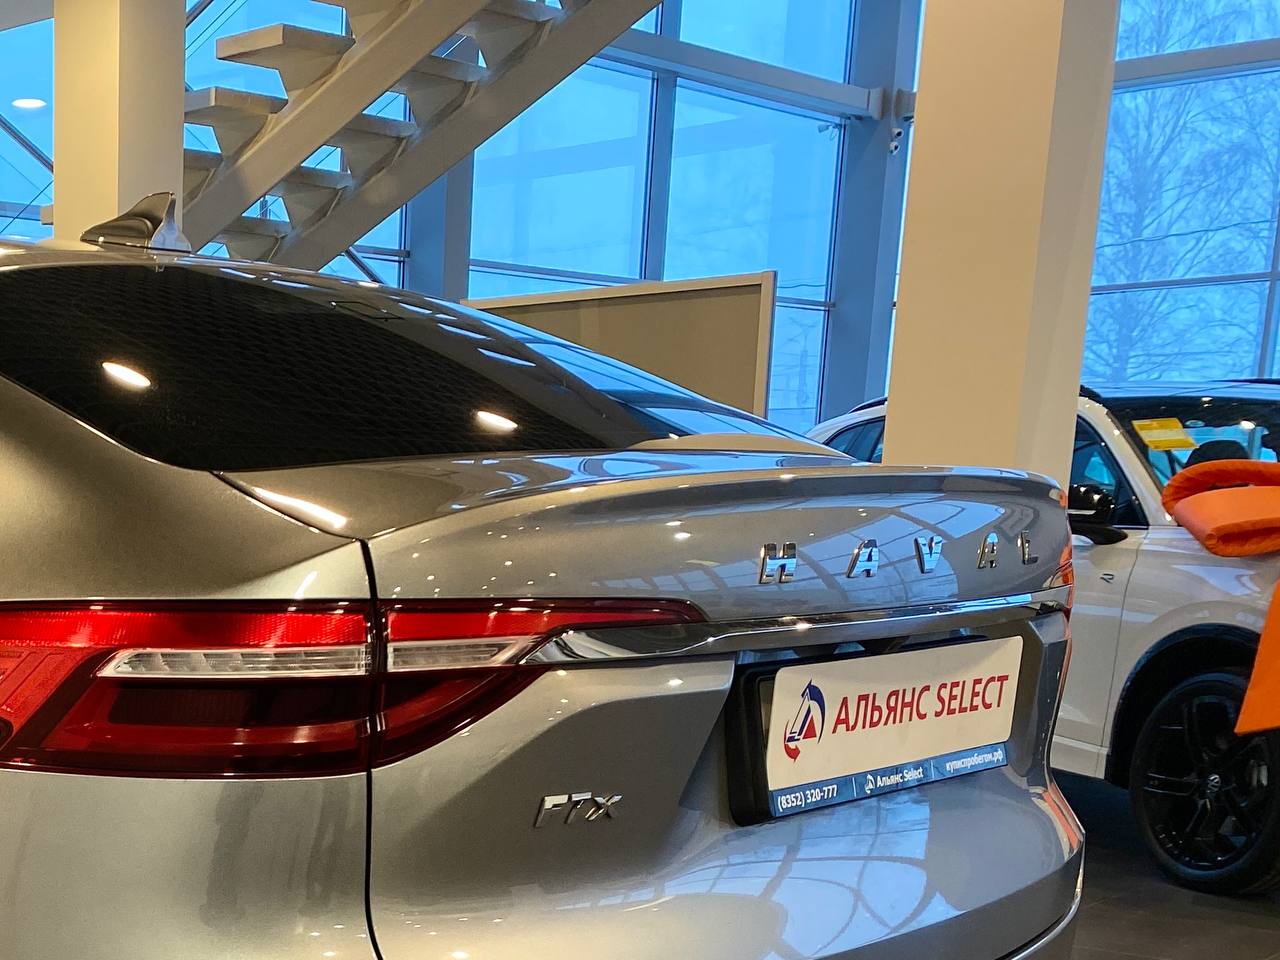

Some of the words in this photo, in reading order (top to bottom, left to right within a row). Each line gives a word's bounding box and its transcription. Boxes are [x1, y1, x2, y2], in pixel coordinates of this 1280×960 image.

[759, 530, 1039, 585] HAVAL
[832, 685, 931, 734] АЛЬЯНС
[934, 674, 1010, 717] SELECT
[777, 791, 805, 812] (8352)
[805, 784, 838, 803] 320-777
[876, 773, 904, 788] Альянс
[903, 766, 924, 781] Select
